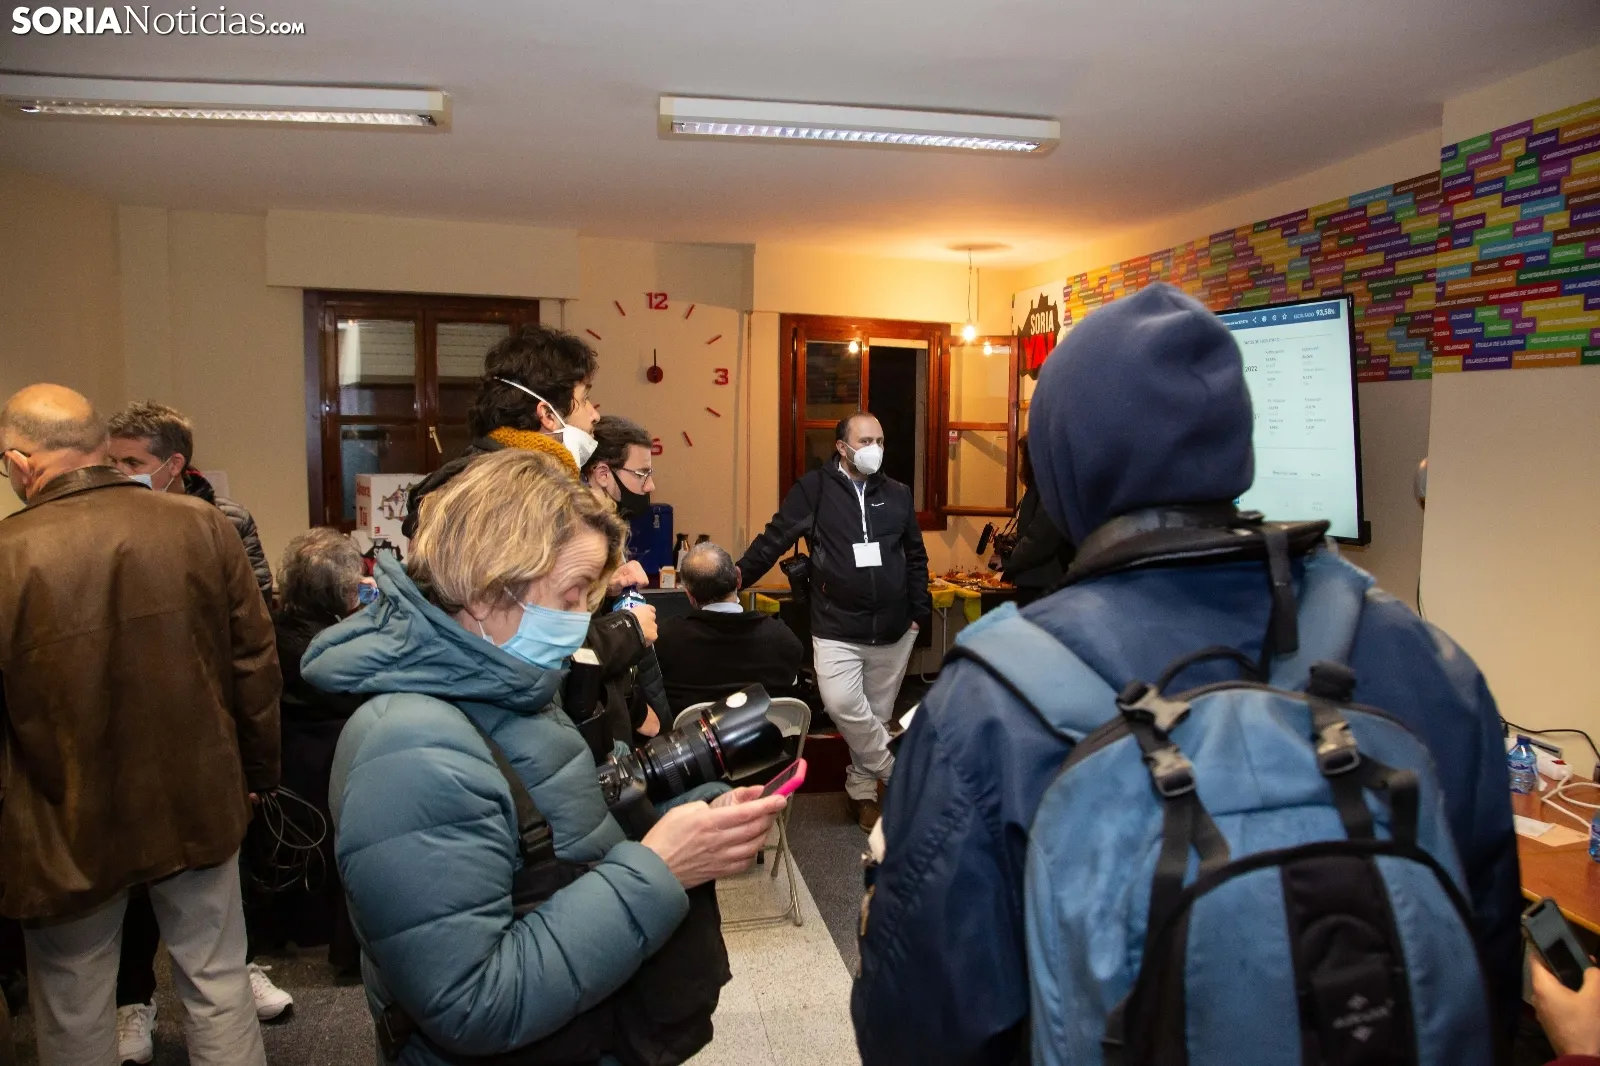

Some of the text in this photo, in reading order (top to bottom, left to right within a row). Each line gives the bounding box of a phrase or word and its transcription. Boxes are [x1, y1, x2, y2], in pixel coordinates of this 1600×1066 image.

[645, 292, 669, 310] 12
[1031, 310, 1055, 335] SORIA
[713, 368, 729, 385] 3
